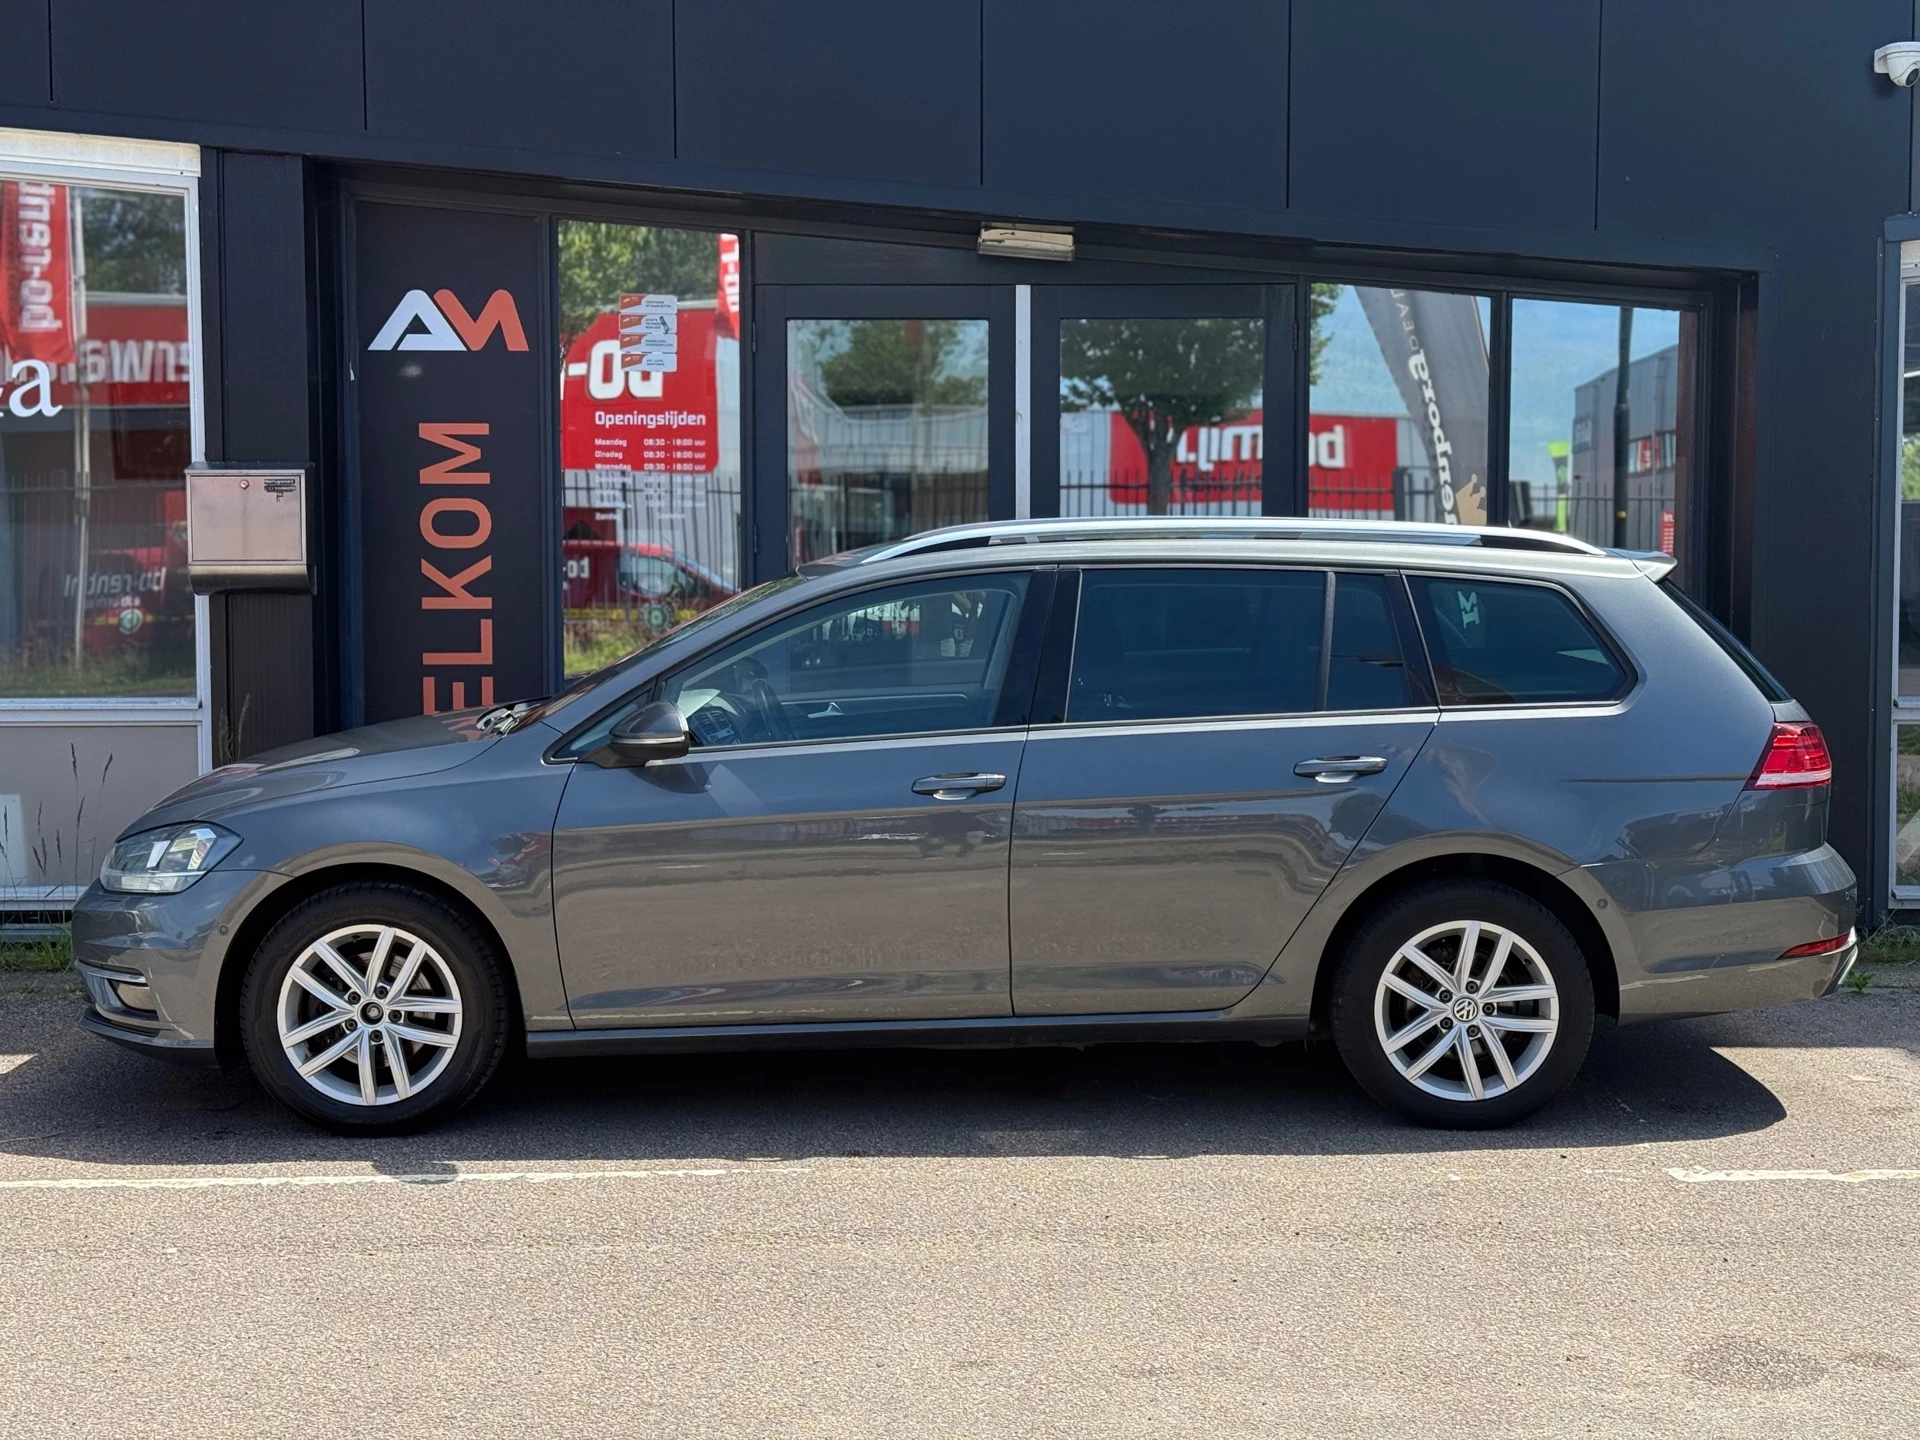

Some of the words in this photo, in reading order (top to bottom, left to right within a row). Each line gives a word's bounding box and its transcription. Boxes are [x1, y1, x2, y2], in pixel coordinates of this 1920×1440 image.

[0, 358, 63, 418] a
[595, 410, 706, 429] Openingstijden
[595, 438, 627, 447] Maandag
[595, 451, 623, 460] Dinsdag
[418, 423, 494, 716] ELKOM
